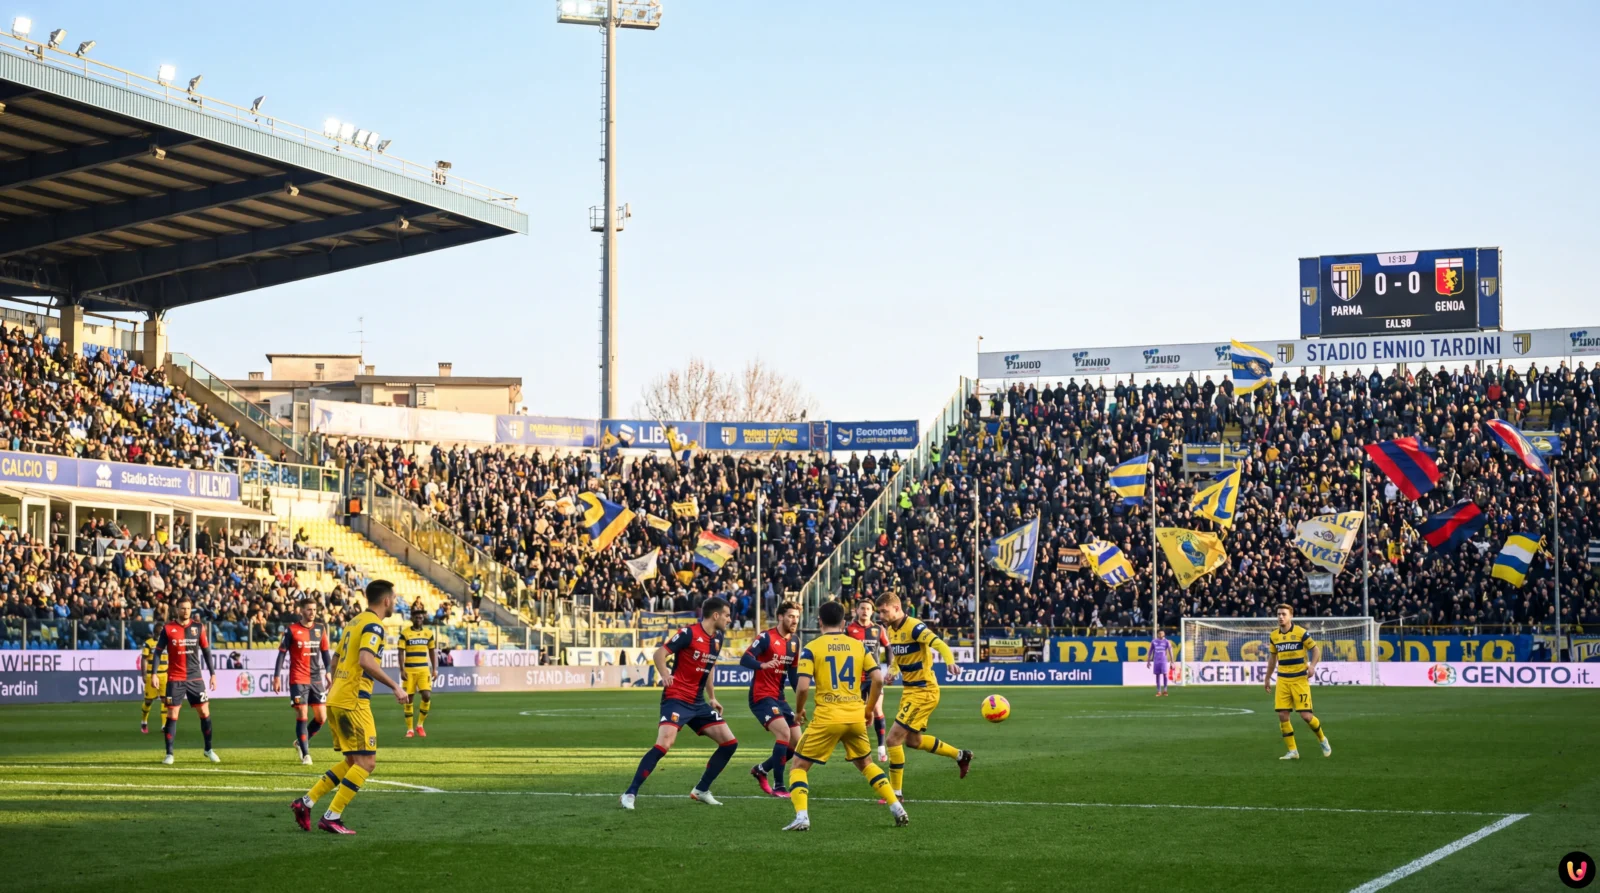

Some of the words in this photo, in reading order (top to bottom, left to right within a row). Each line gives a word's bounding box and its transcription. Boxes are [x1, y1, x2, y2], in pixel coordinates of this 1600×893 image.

[1375, 272, 1387, 296] 0
[1408, 271, 1420, 294] 0
[1331, 304, 1363, 316] PARMA
[1435, 300, 1465, 312] GENOA
[1307, 341, 1367, 361] STADIO
[1373, 339, 1425, 359] ENNIO
[1430, 336, 1501, 357] TARDINI
[2, 457, 43, 478] CALCIO
[121, 471, 147, 486] Stadio
[447, 673, 471, 687] Ennio
[472, 672, 500, 687] Tardini
[526, 670, 563, 685] STAND
[825, 655, 855, 690] 14
[945, 666, 1005, 682] Stadio
[1009, 669, 1046, 681] Ennio
[1049, 668, 1092, 681] Tardini
[78, 676, 135, 696] STAND
